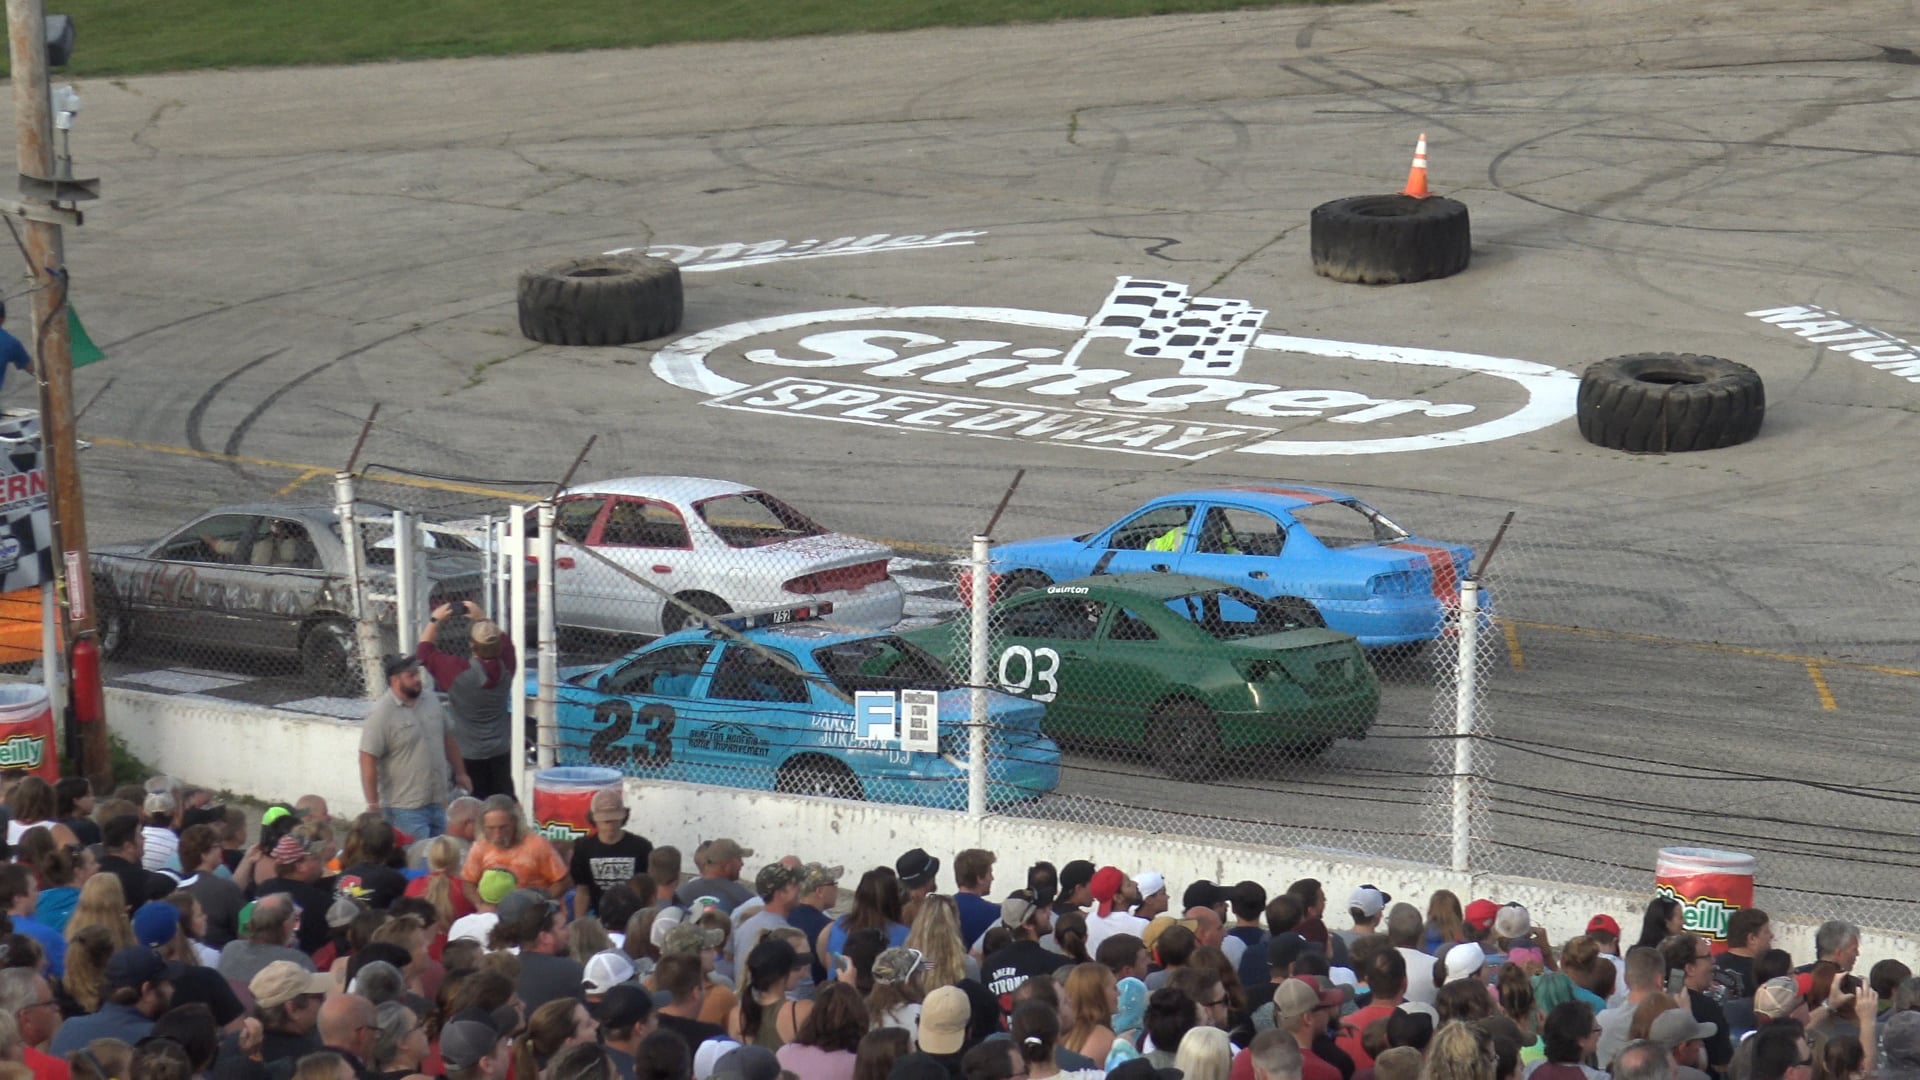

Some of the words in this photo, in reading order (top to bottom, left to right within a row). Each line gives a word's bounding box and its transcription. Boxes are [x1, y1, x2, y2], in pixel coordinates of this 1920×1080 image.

[1744, 304, 1920, 384] NATION
[745, 329, 1476, 424] Slinger
[743, 384, 1247, 451] SPEEDWAY
[1047, 586, 1089, 595] Quinton
[999, 645, 1060, 704] 03
[590, 699, 676, 768] 23
[858, 696, 893, 737] F
[889, 749, 911, 764] DJ
